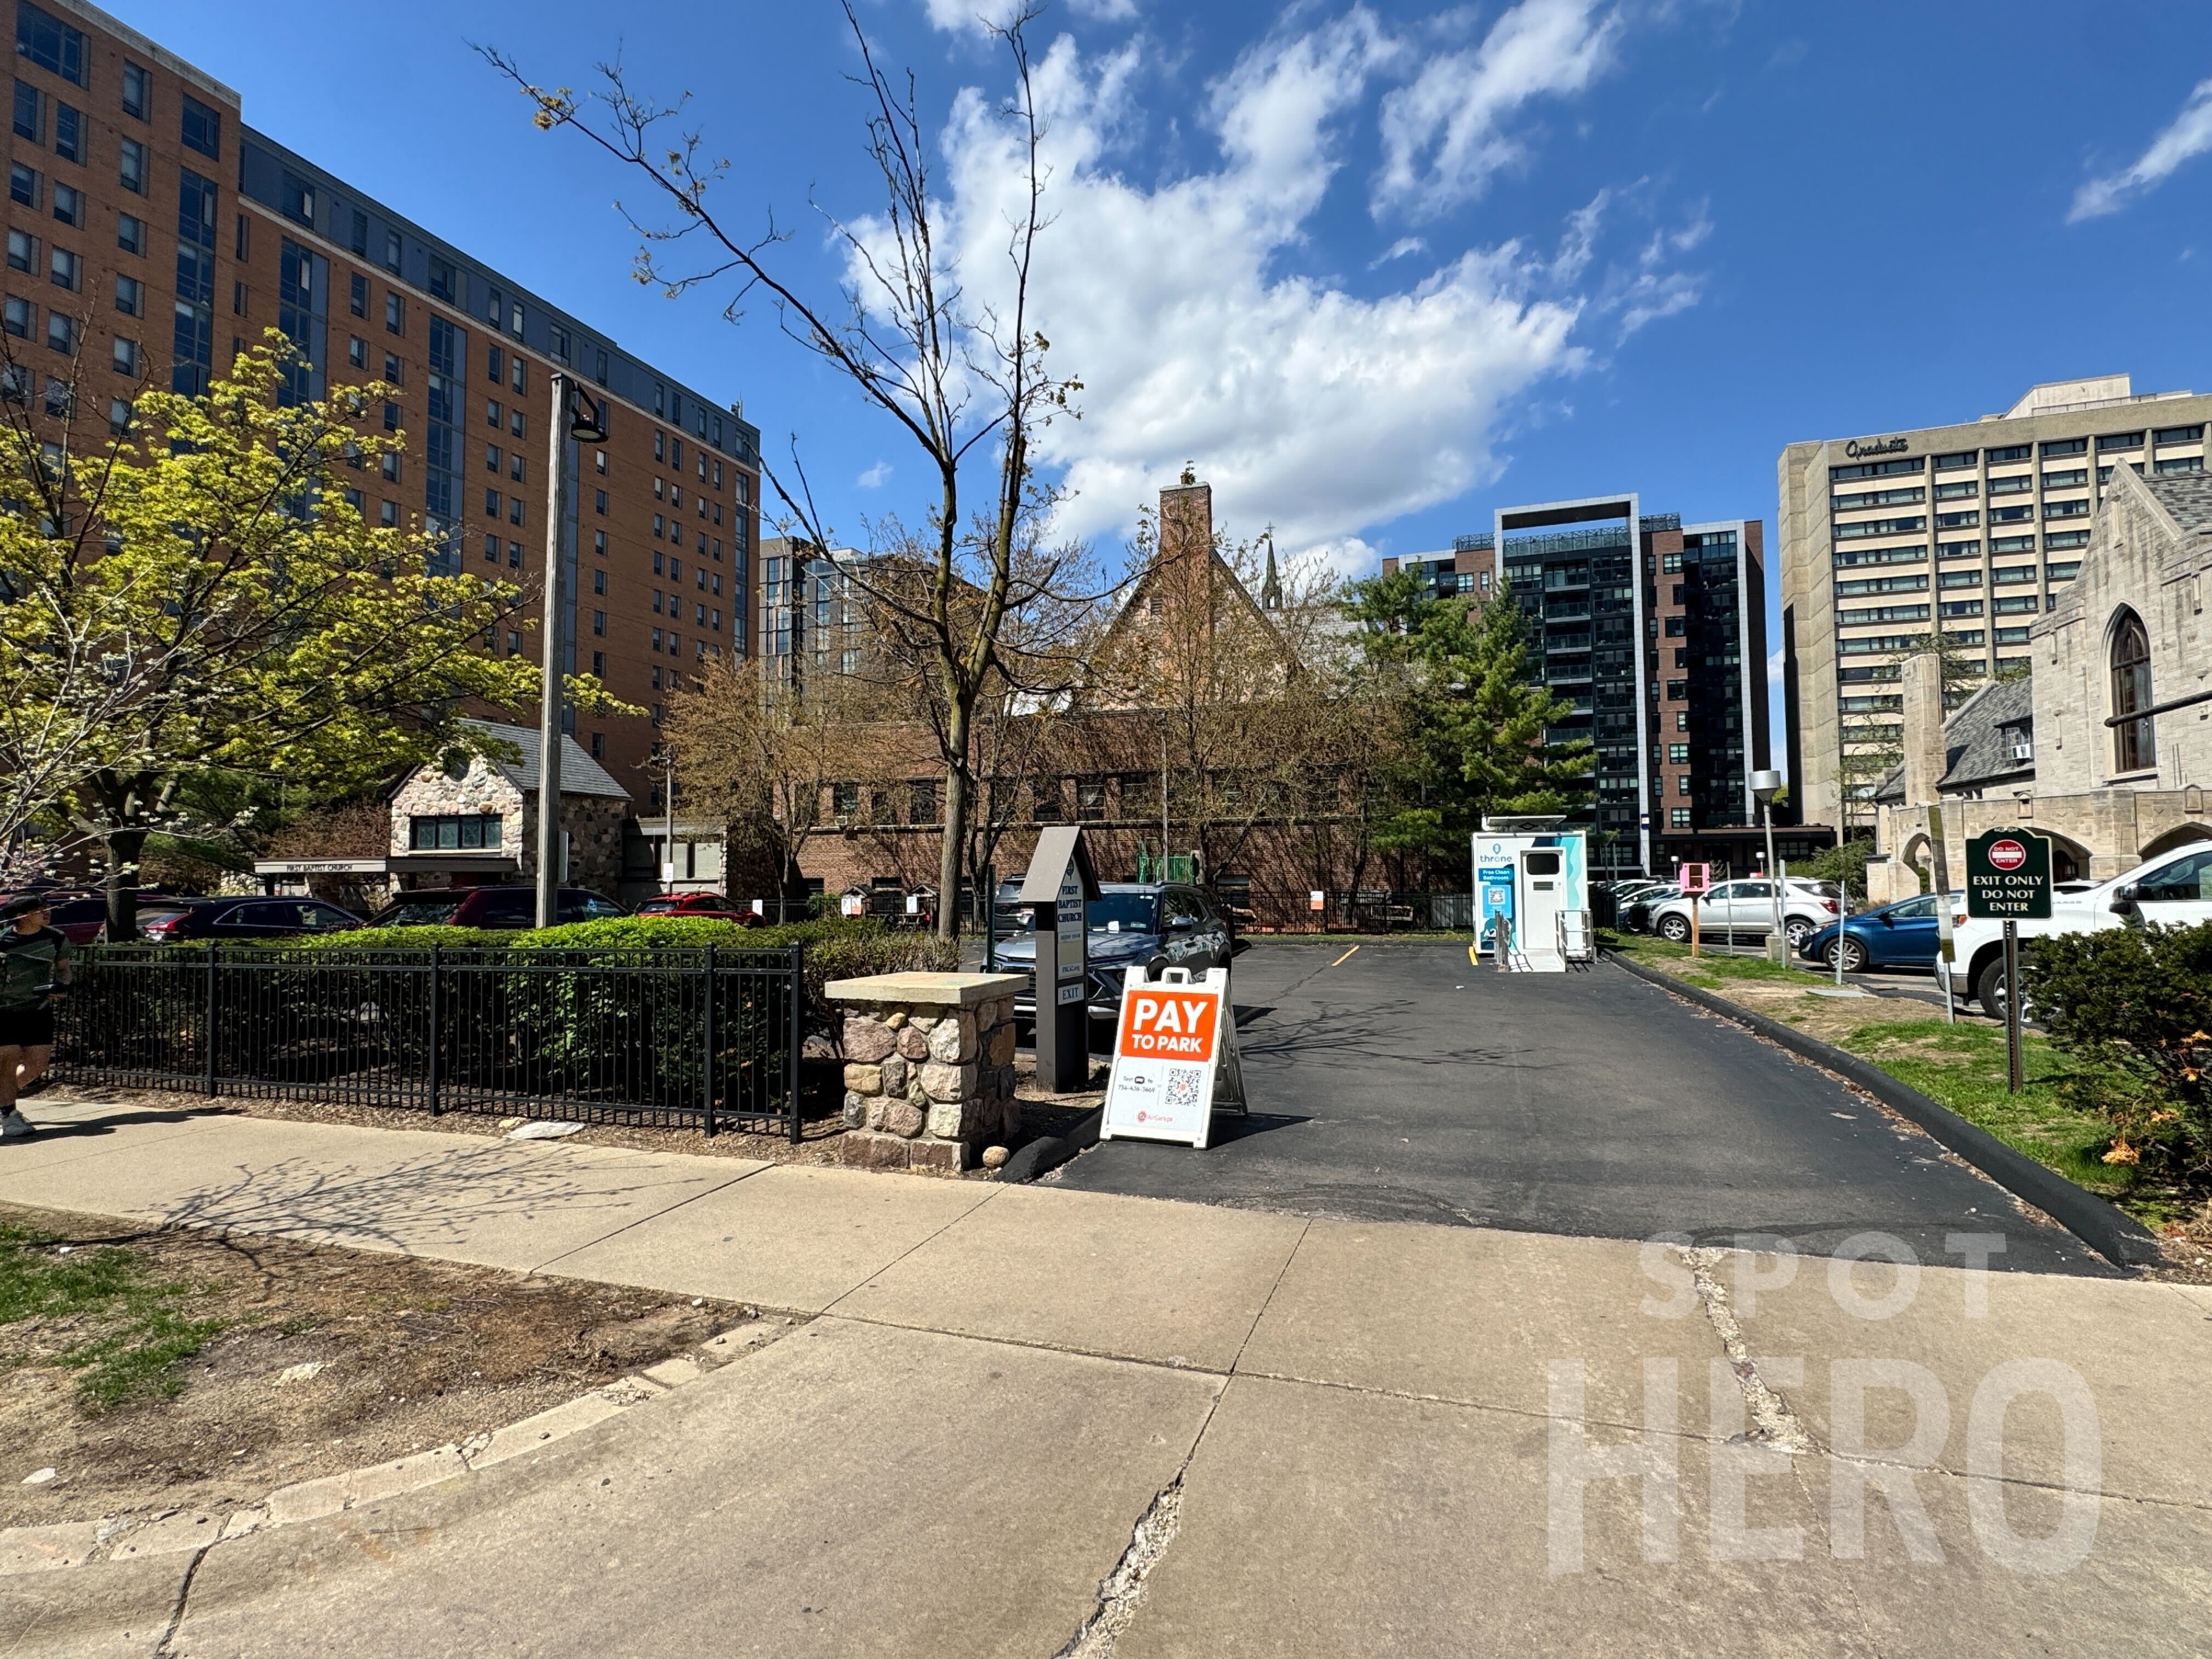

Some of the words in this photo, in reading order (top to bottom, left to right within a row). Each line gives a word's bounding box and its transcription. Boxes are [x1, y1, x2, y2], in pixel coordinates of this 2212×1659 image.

[1845, 436, 1909, 461] Graduate
[1973, 876, 2001, 885] EXIT
[2005, 876, 2043, 885] ONLY
[1062, 885, 1078, 895] FIRST
[1982, 890, 2003, 899] DO
[2007, 890, 2035, 899] NOT
[1058, 899, 1082, 909] BAPTIST
[1990, 902, 2029, 911] ENTER
[1058, 912, 1082, 923] CHURCH
[1062, 987, 1079, 1000] EXIT
[1132, 998, 1209, 1034] PAY
[1131, 1033, 1155, 1050] TO
[1157, 1035, 1203, 1053] PARK
